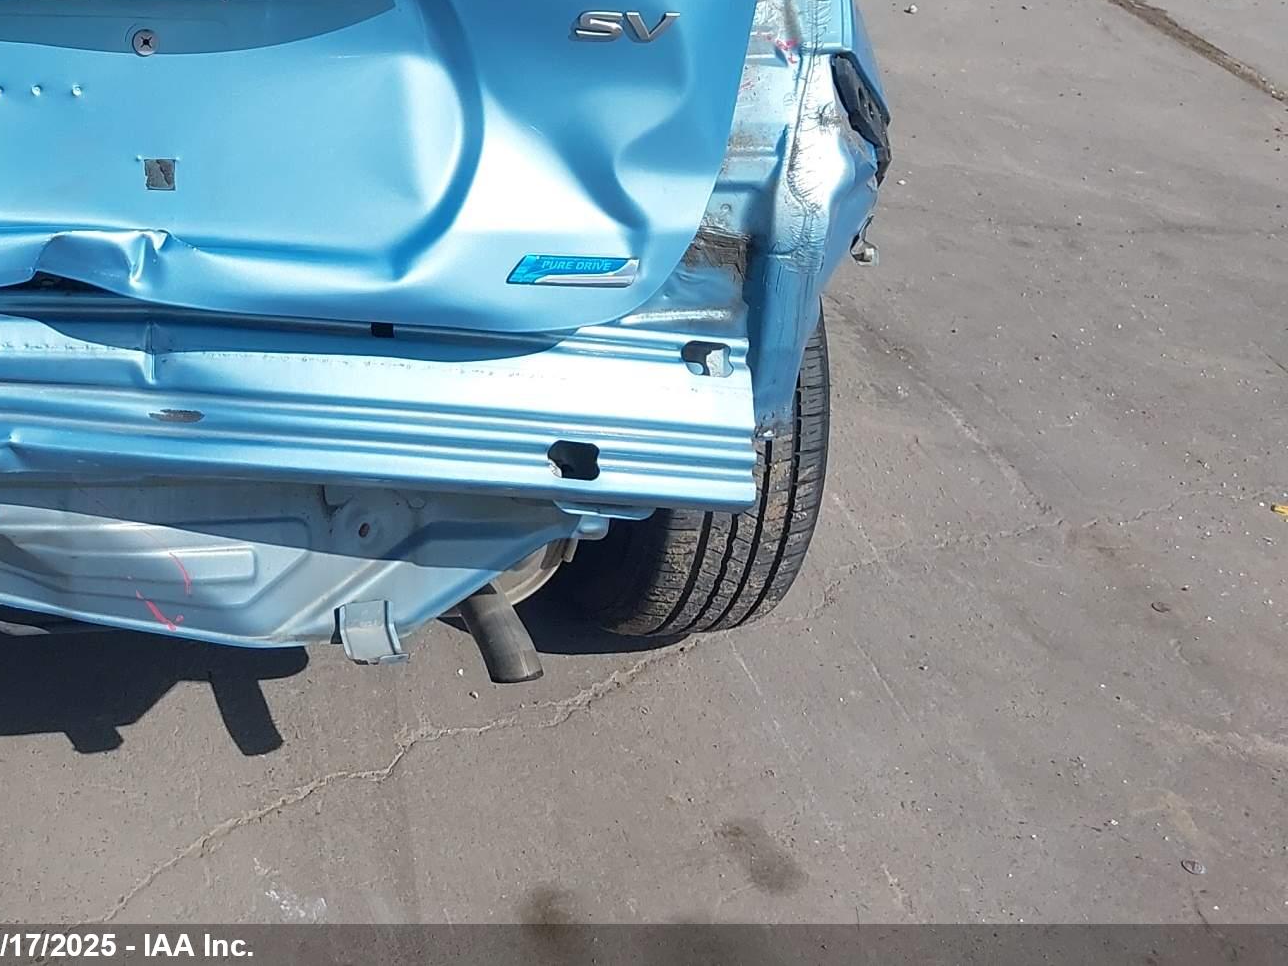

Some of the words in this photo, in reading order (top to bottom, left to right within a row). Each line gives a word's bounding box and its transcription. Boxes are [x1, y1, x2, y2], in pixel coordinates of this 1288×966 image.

[575, 10, 681, 42] SV
[541, 260, 574, 271] PURE
[575, 261, 613, 272] DRIVE
